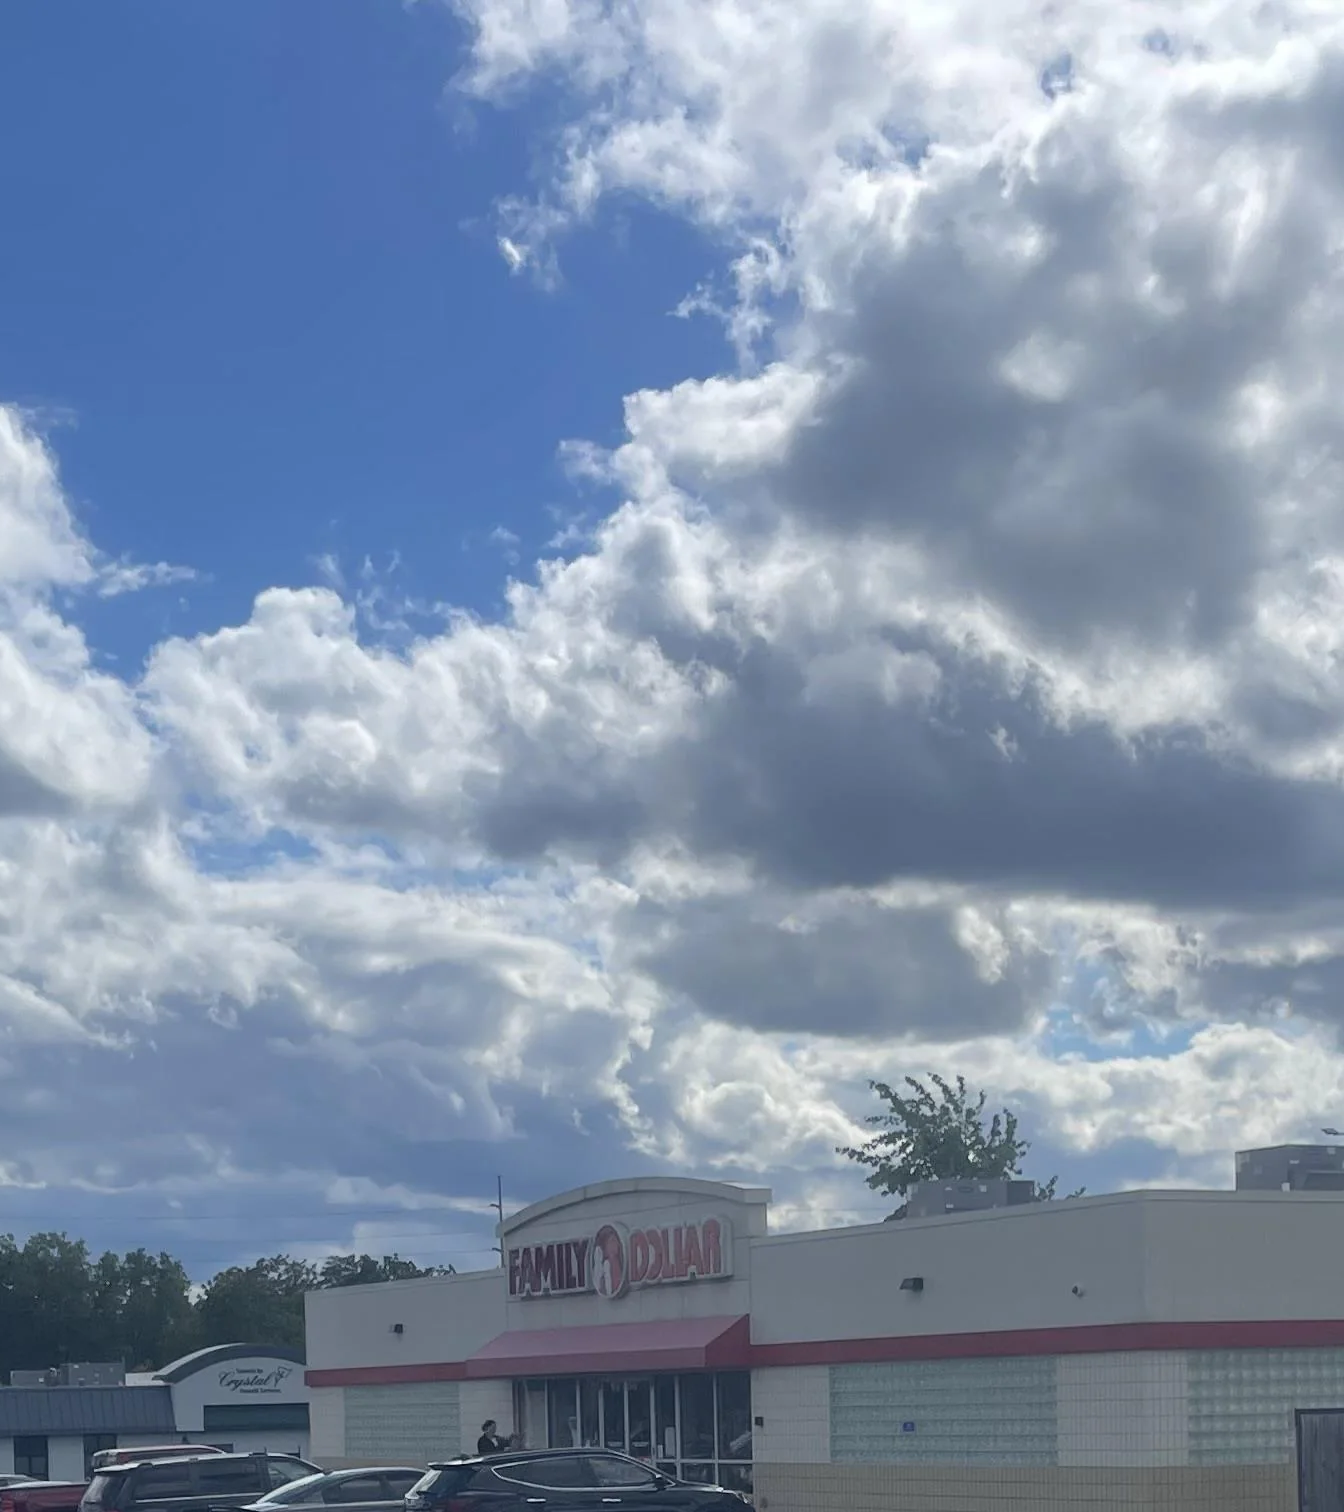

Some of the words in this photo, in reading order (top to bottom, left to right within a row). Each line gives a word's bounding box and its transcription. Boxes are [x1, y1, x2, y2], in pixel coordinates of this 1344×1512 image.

[508, 1237, 592, 1297] FAMILY
[628, 1216, 724, 1284] DOLLAR
[218, 1370, 275, 1392] Crystal
